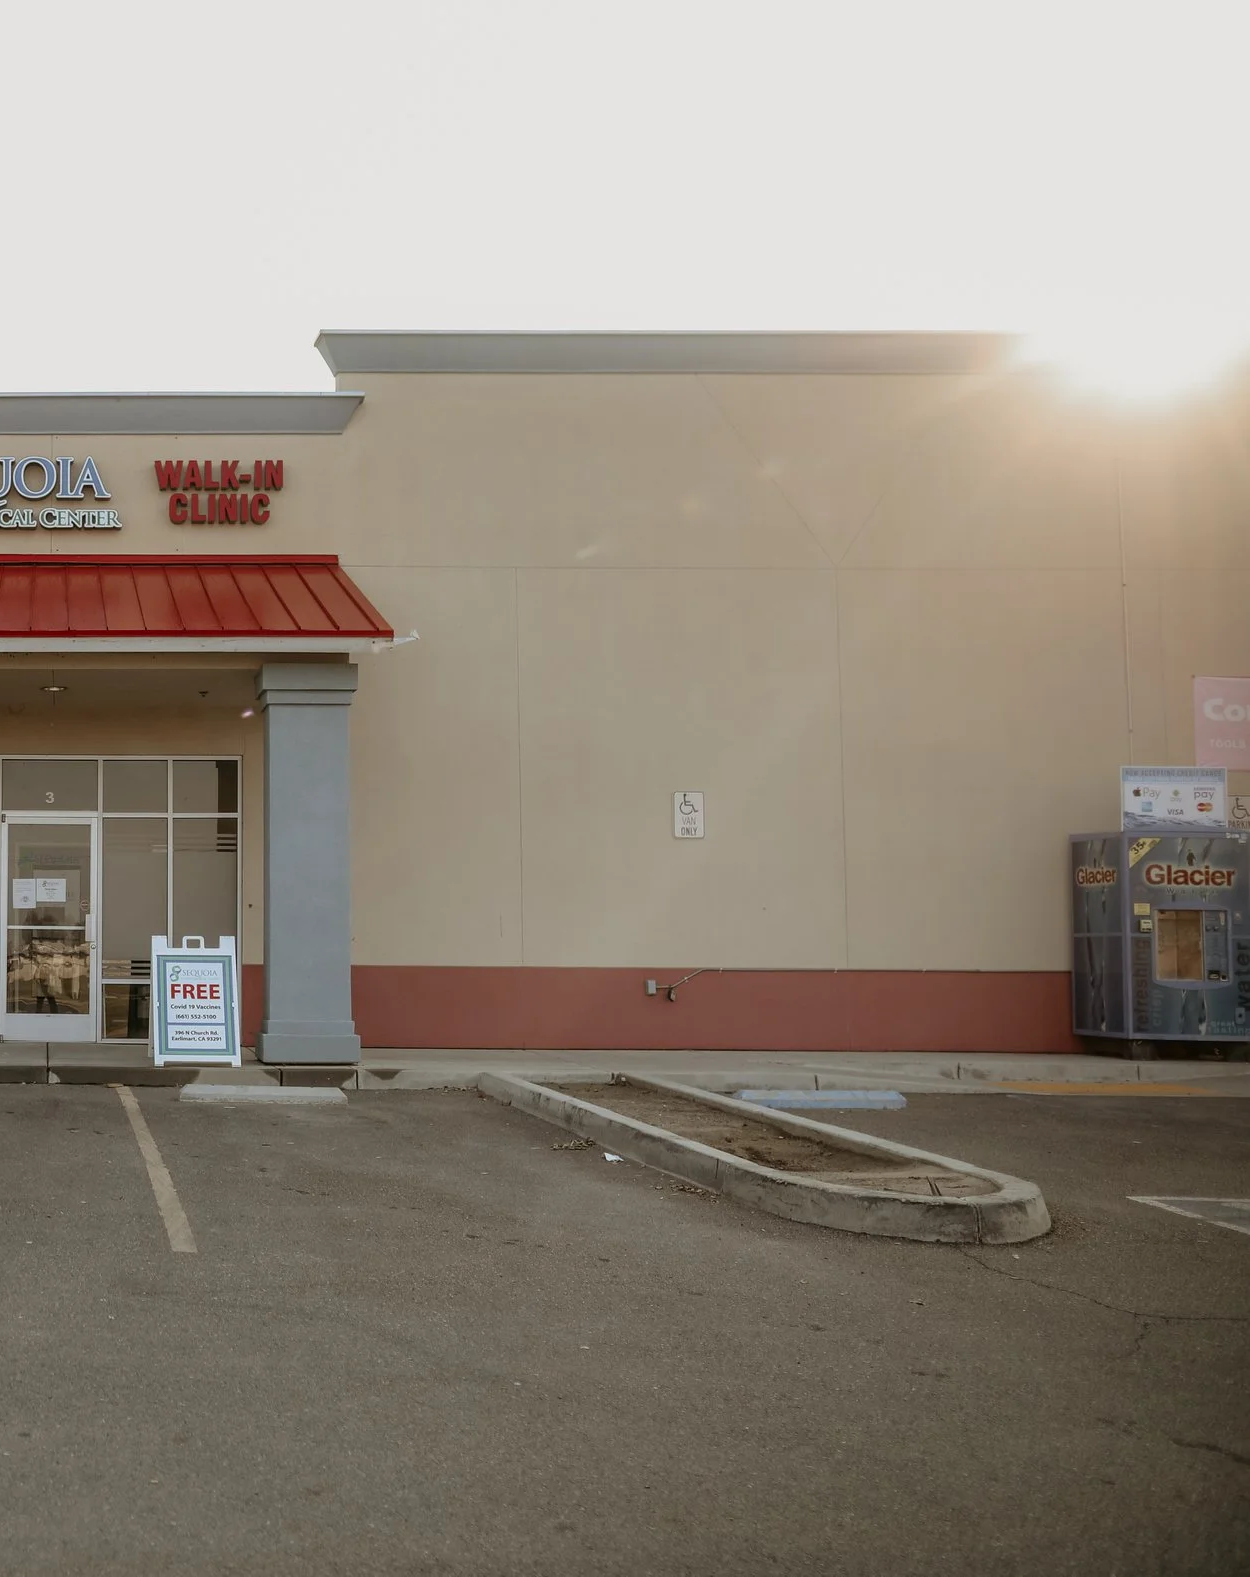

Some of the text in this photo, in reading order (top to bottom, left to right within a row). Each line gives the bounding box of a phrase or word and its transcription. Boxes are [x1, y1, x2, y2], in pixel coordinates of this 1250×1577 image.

[154, 460, 284, 491] WALK-IN
[168, 493, 271, 525] CLINIC
[39, 508, 123, 530] CENTER
[1203, 698, 1250, 722] Co
[45, 792, 55, 804] 3
[1143, 787, 1161, 800] Pay
[682, 816, 696, 825] VAN
[680, 827, 698, 836] ONLY
[1077, 866, 1117, 885] Glacier
[1145, 864, 1237, 886] Glacier
[182, 969, 218, 977] SEQUOIA
[170, 984, 221, 1000] FREE
[1134, 940, 1150, 1031] refreshing
